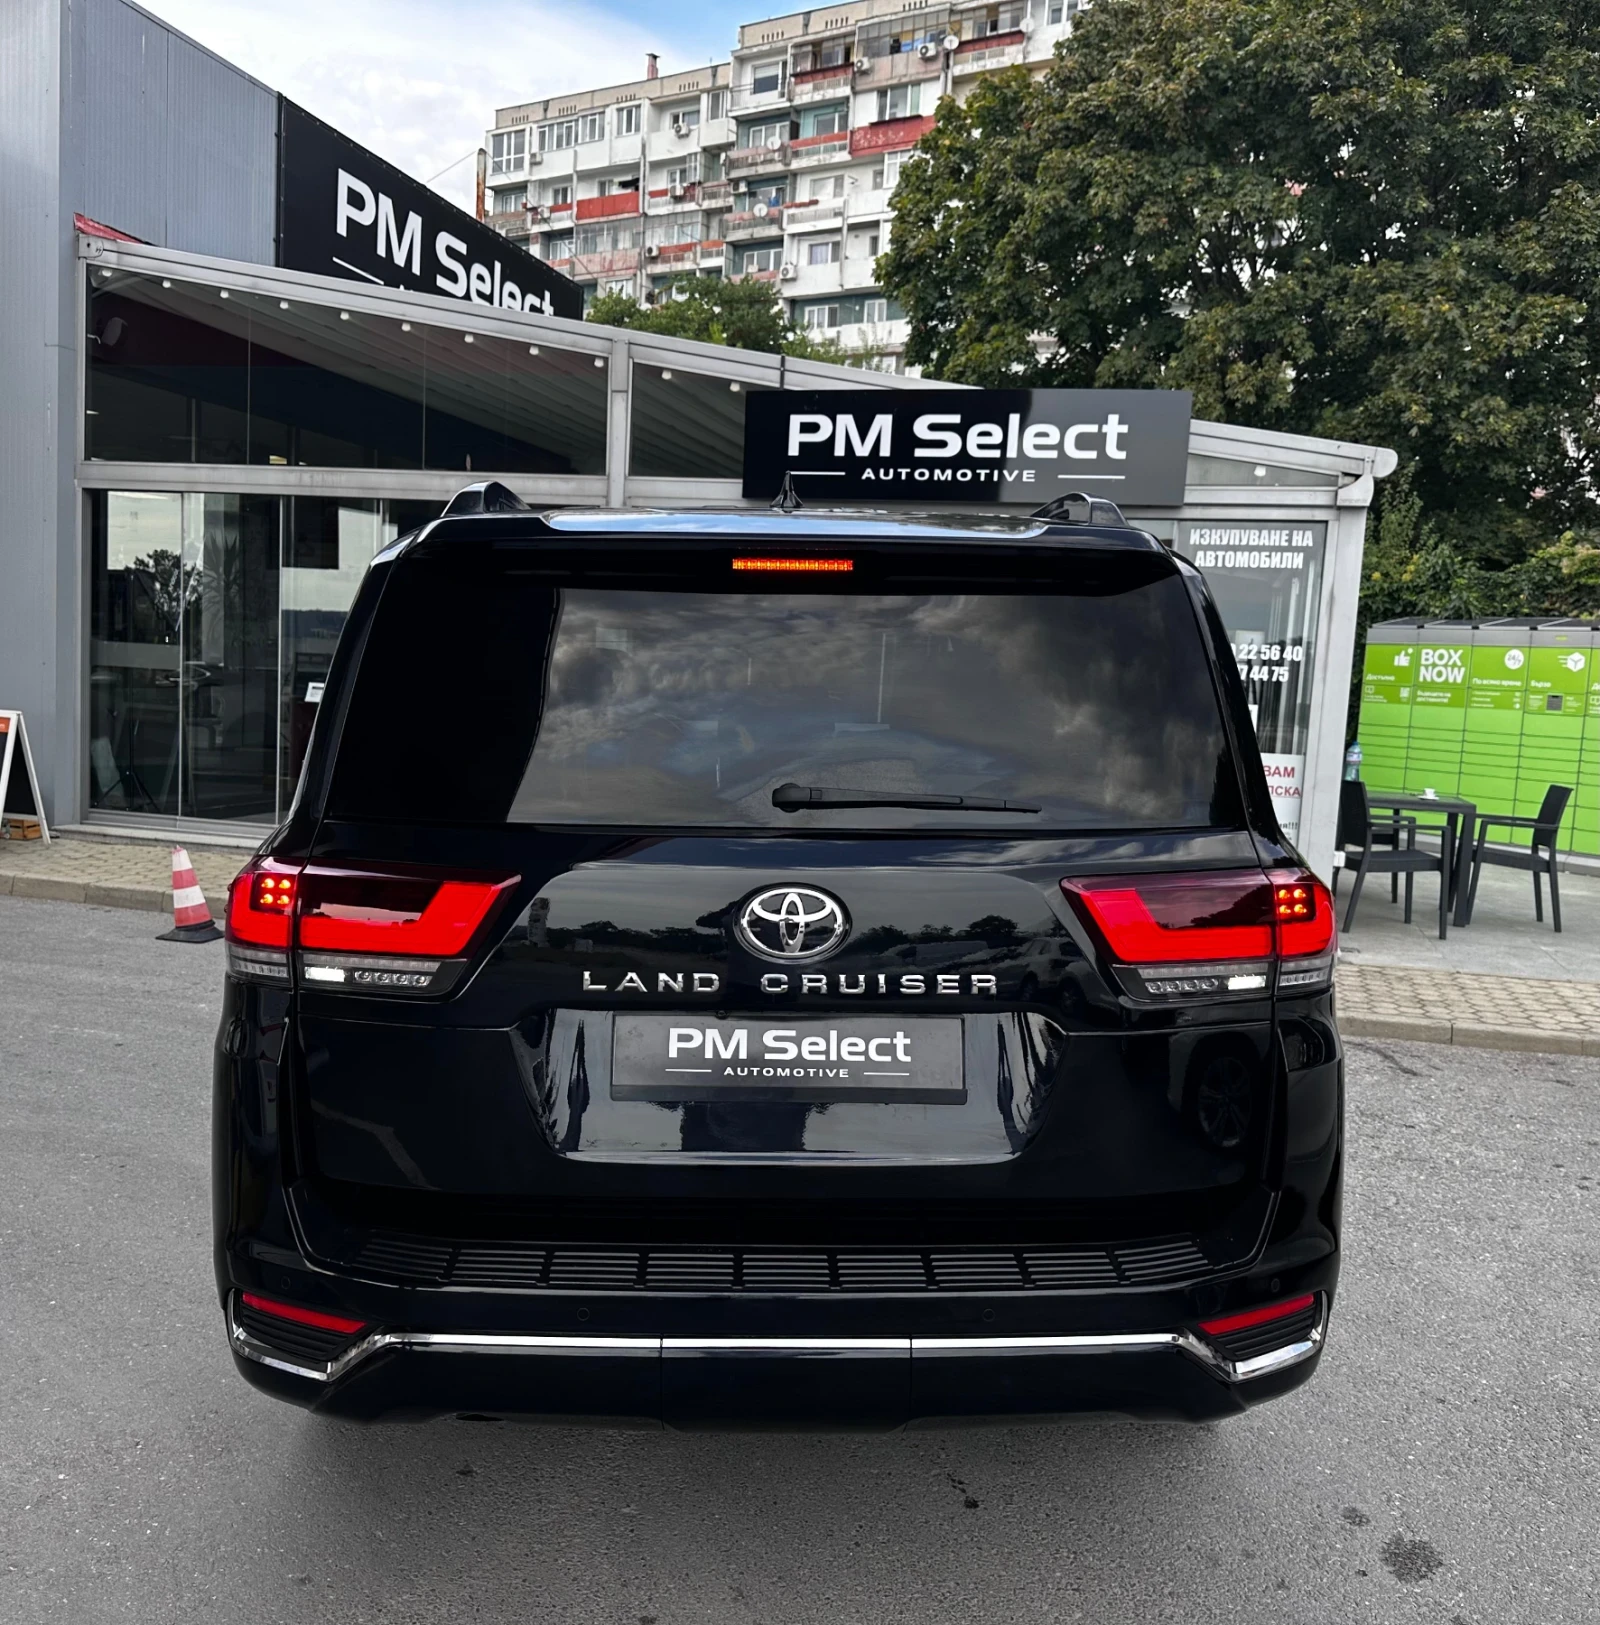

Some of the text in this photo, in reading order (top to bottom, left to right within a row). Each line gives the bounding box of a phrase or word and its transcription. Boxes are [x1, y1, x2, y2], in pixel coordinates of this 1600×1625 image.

[336, 168, 423, 276] PM
[787, 413, 1129, 460] PM Select
[861, 467, 1036, 483] AUTOMOTIVE
[1189, 528, 1314, 547] ИЗКУПУВАНЕ НА
[1194, 550, 1304, 569] АВТОМОБИЛИ
[1238, 643, 1258, 660] 22
[1260, 644, 1281, 660] 56
[1282, 645, 1303, 661] 40
[1421, 648, 1464, 666] BOX
[1271, 666, 1290, 682] 75
[1419, 666, 1466, 683] NOW
[583, 970, 998, 996] LAND CRUISER
[668, 1027, 912, 1063] PM Select
[724, 1066, 849, 1078] AUTOMOTIVE
